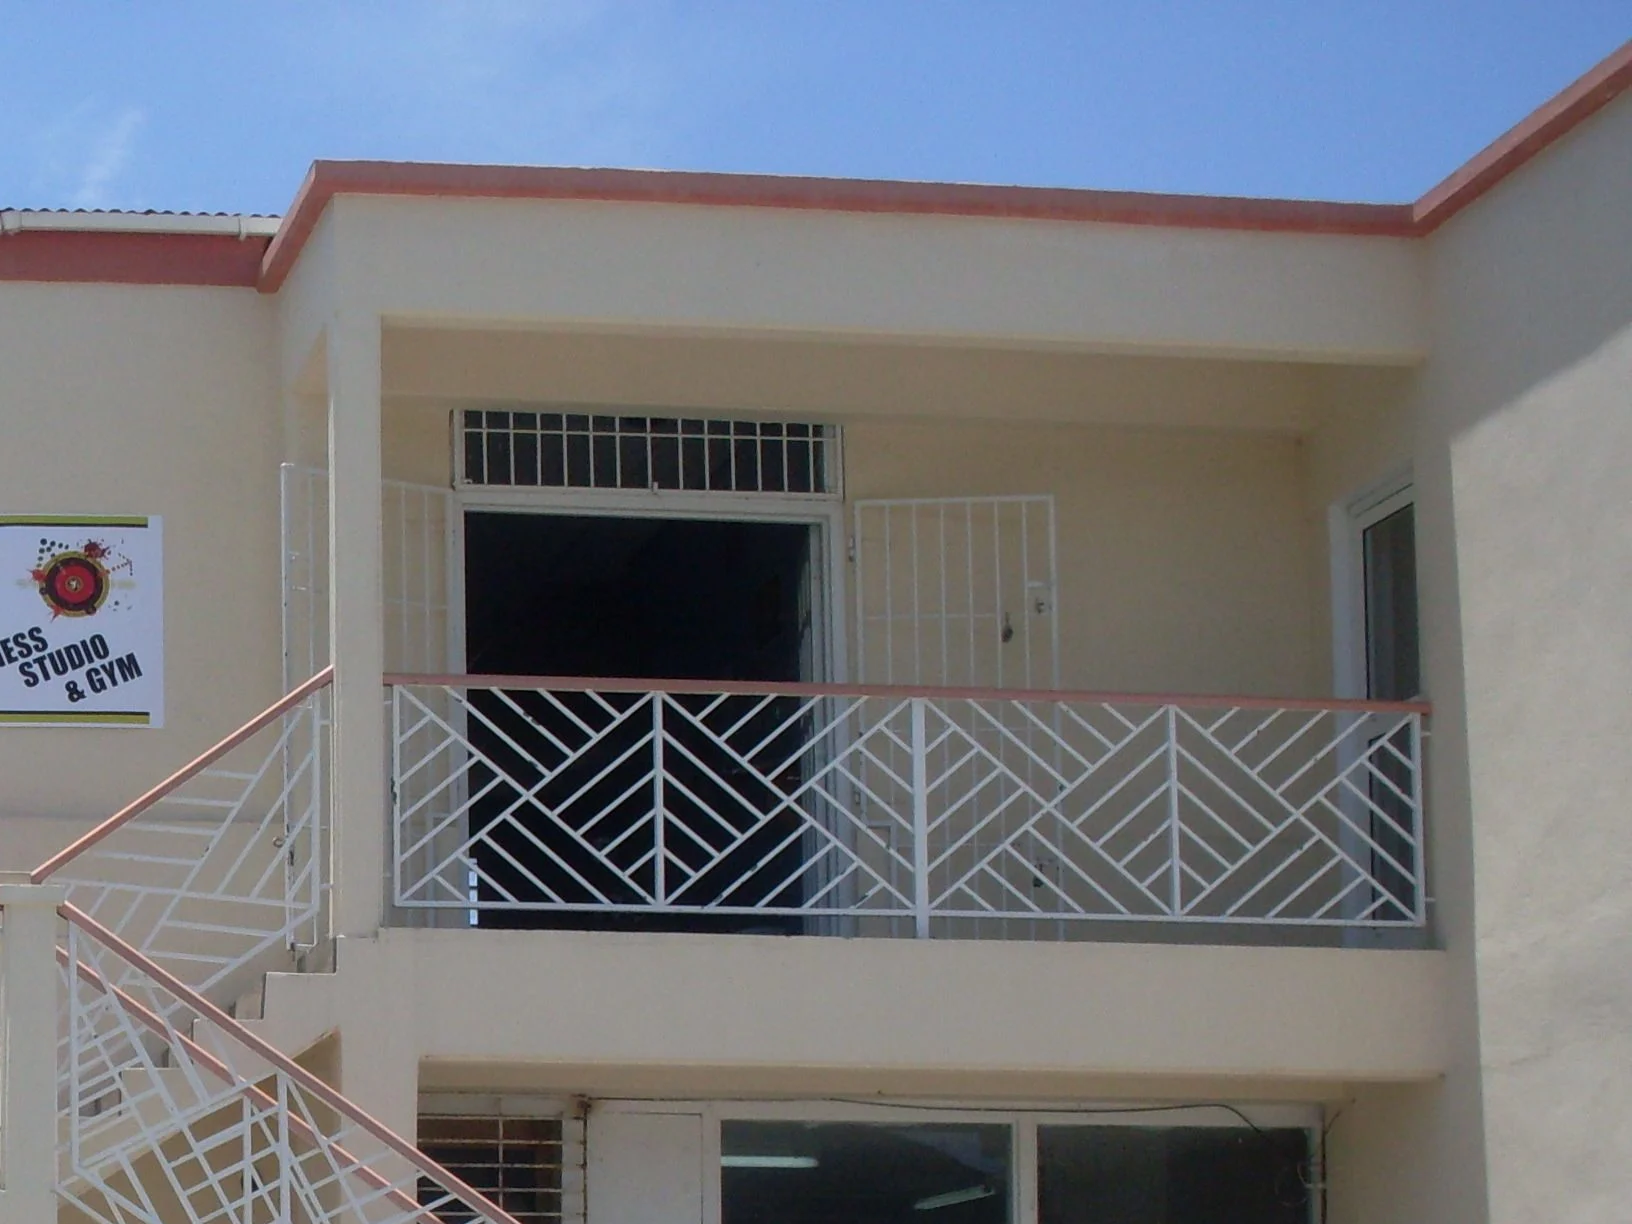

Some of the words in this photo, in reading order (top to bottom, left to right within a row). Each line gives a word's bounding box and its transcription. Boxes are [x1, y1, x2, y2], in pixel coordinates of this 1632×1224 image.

[18, 634, 110, 688] STUDIO
[65, 680, 86, 703] &
[86, 652, 143, 694] GYM
